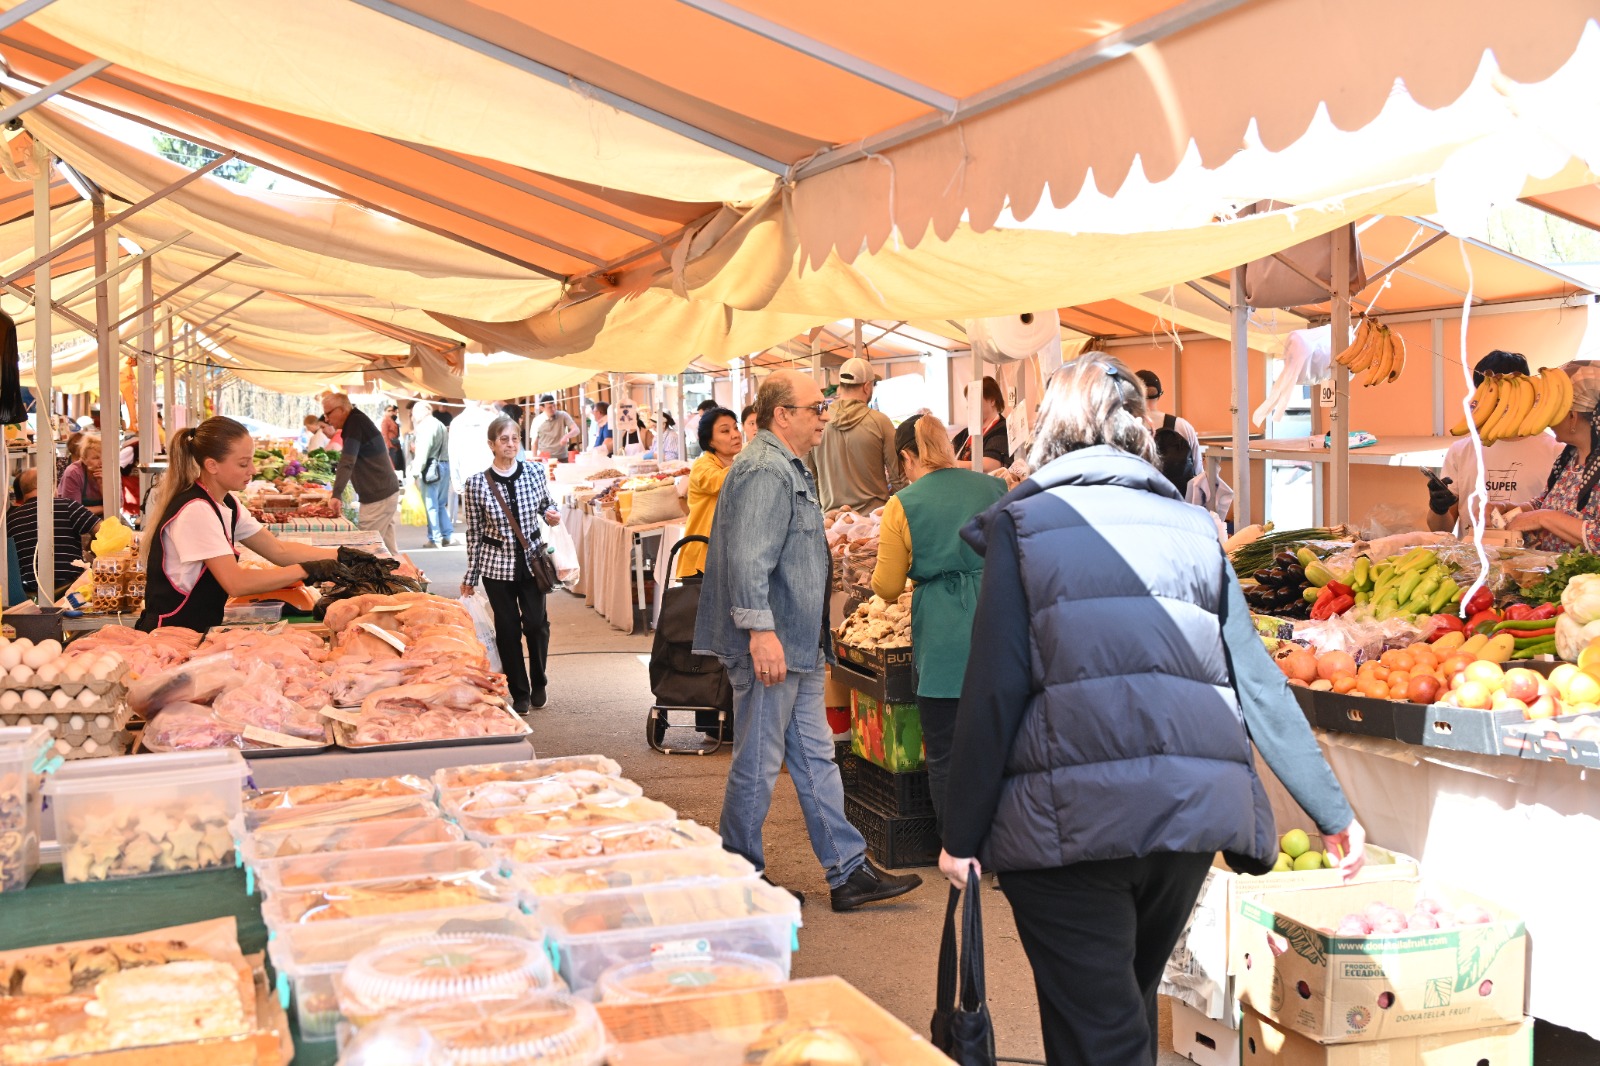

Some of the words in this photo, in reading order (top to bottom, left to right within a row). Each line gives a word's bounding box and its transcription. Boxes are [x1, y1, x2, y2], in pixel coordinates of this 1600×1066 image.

[1485, 481, 1517, 491] SUPER
[1395, 1011, 1446, 1023] DONATELLA
[1449, 1007, 1471, 1016] FRUIT
